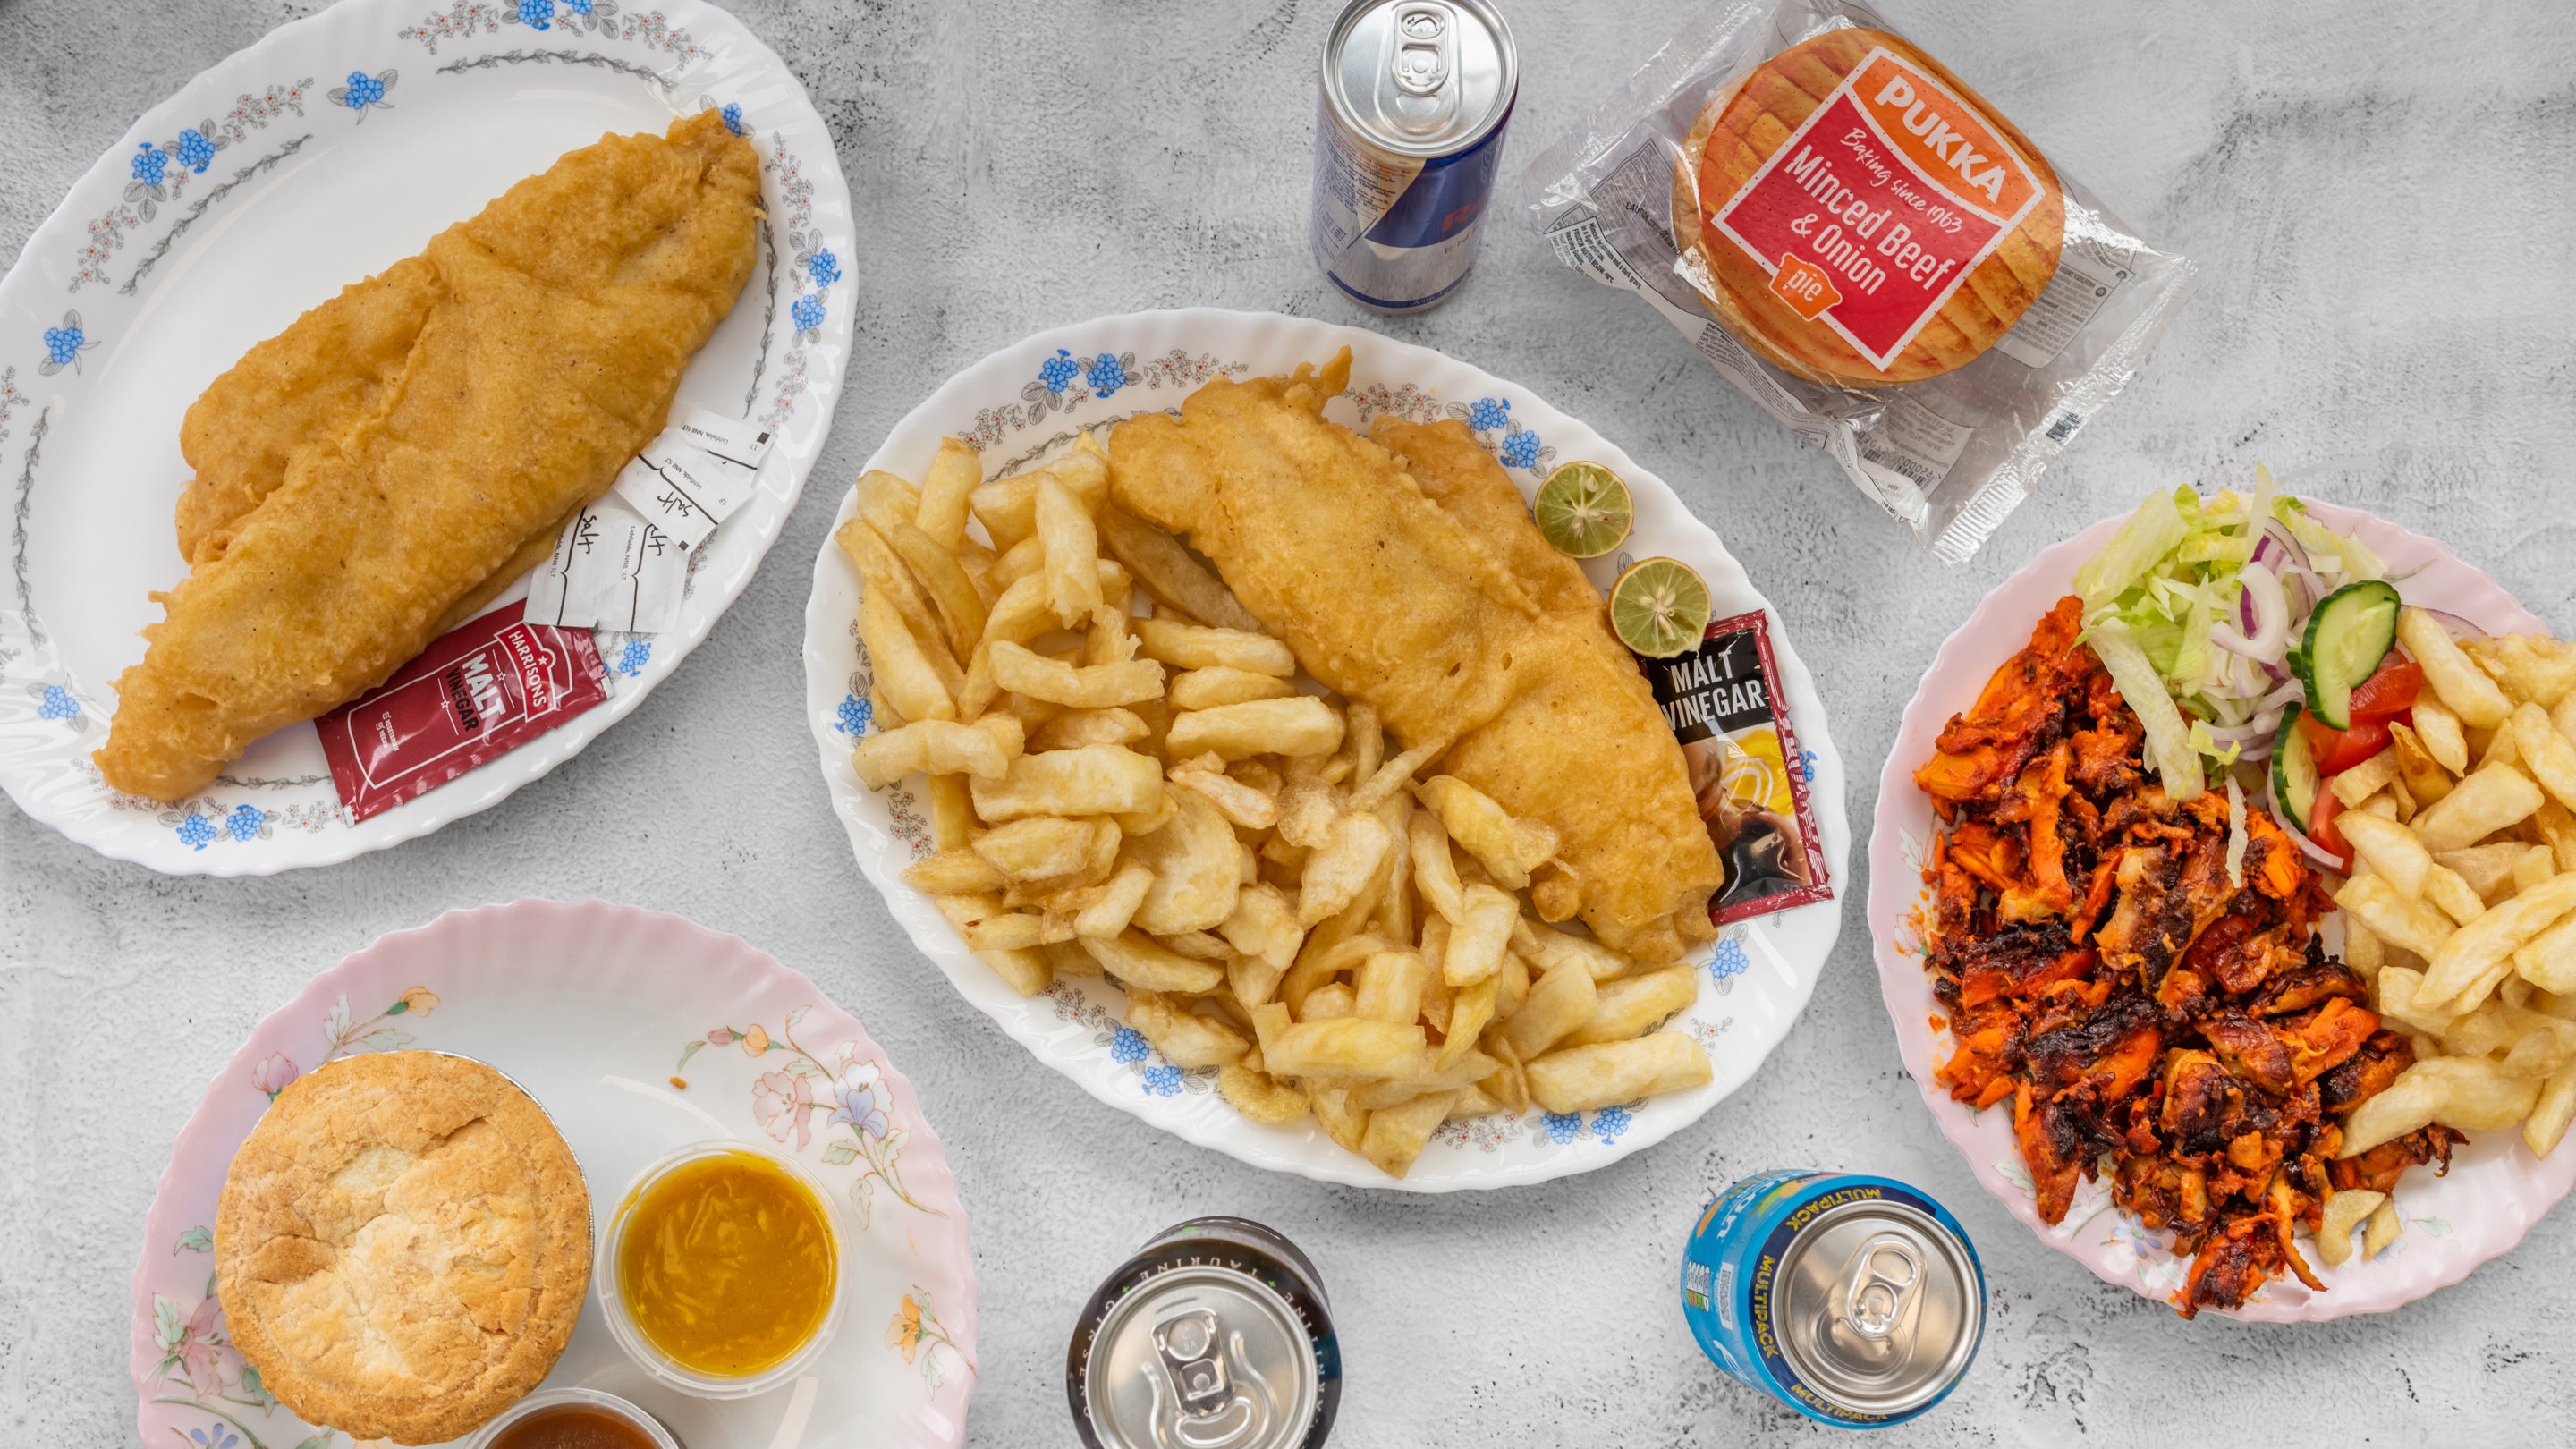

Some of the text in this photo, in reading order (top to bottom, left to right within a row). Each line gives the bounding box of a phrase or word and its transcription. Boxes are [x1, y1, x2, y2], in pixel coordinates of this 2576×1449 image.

[1874, 75, 2007, 204] PUKKA
[1840, 127, 1962, 234] Baking since 1963
[1784, 144, 1956, 291] Minced Beef
[1791, 212, 1887, 296] & Onion
[1786, 267, 1824, 302] pie
[749, 442, 758, 451] 17
[462, 652, 505, 718] MALT
[507, 629, 548, 708] HARRISONS
[1670, 649, 1733, 694] MALT
[445, 665, 479, 733] VINEGAR
[1660, 680, 1766, 733] VINEGAR
[385, 719, 400, 753] VEGETARIAN
[1785, 1188, 1881, 1232] MULTIPACK
[1140, 1256, 1258, 1280] TAURINE
[1754, 1255, 1779, 1359] MULTIPACK
[1791, 1383, 1887, 1422] MULTIPACK
